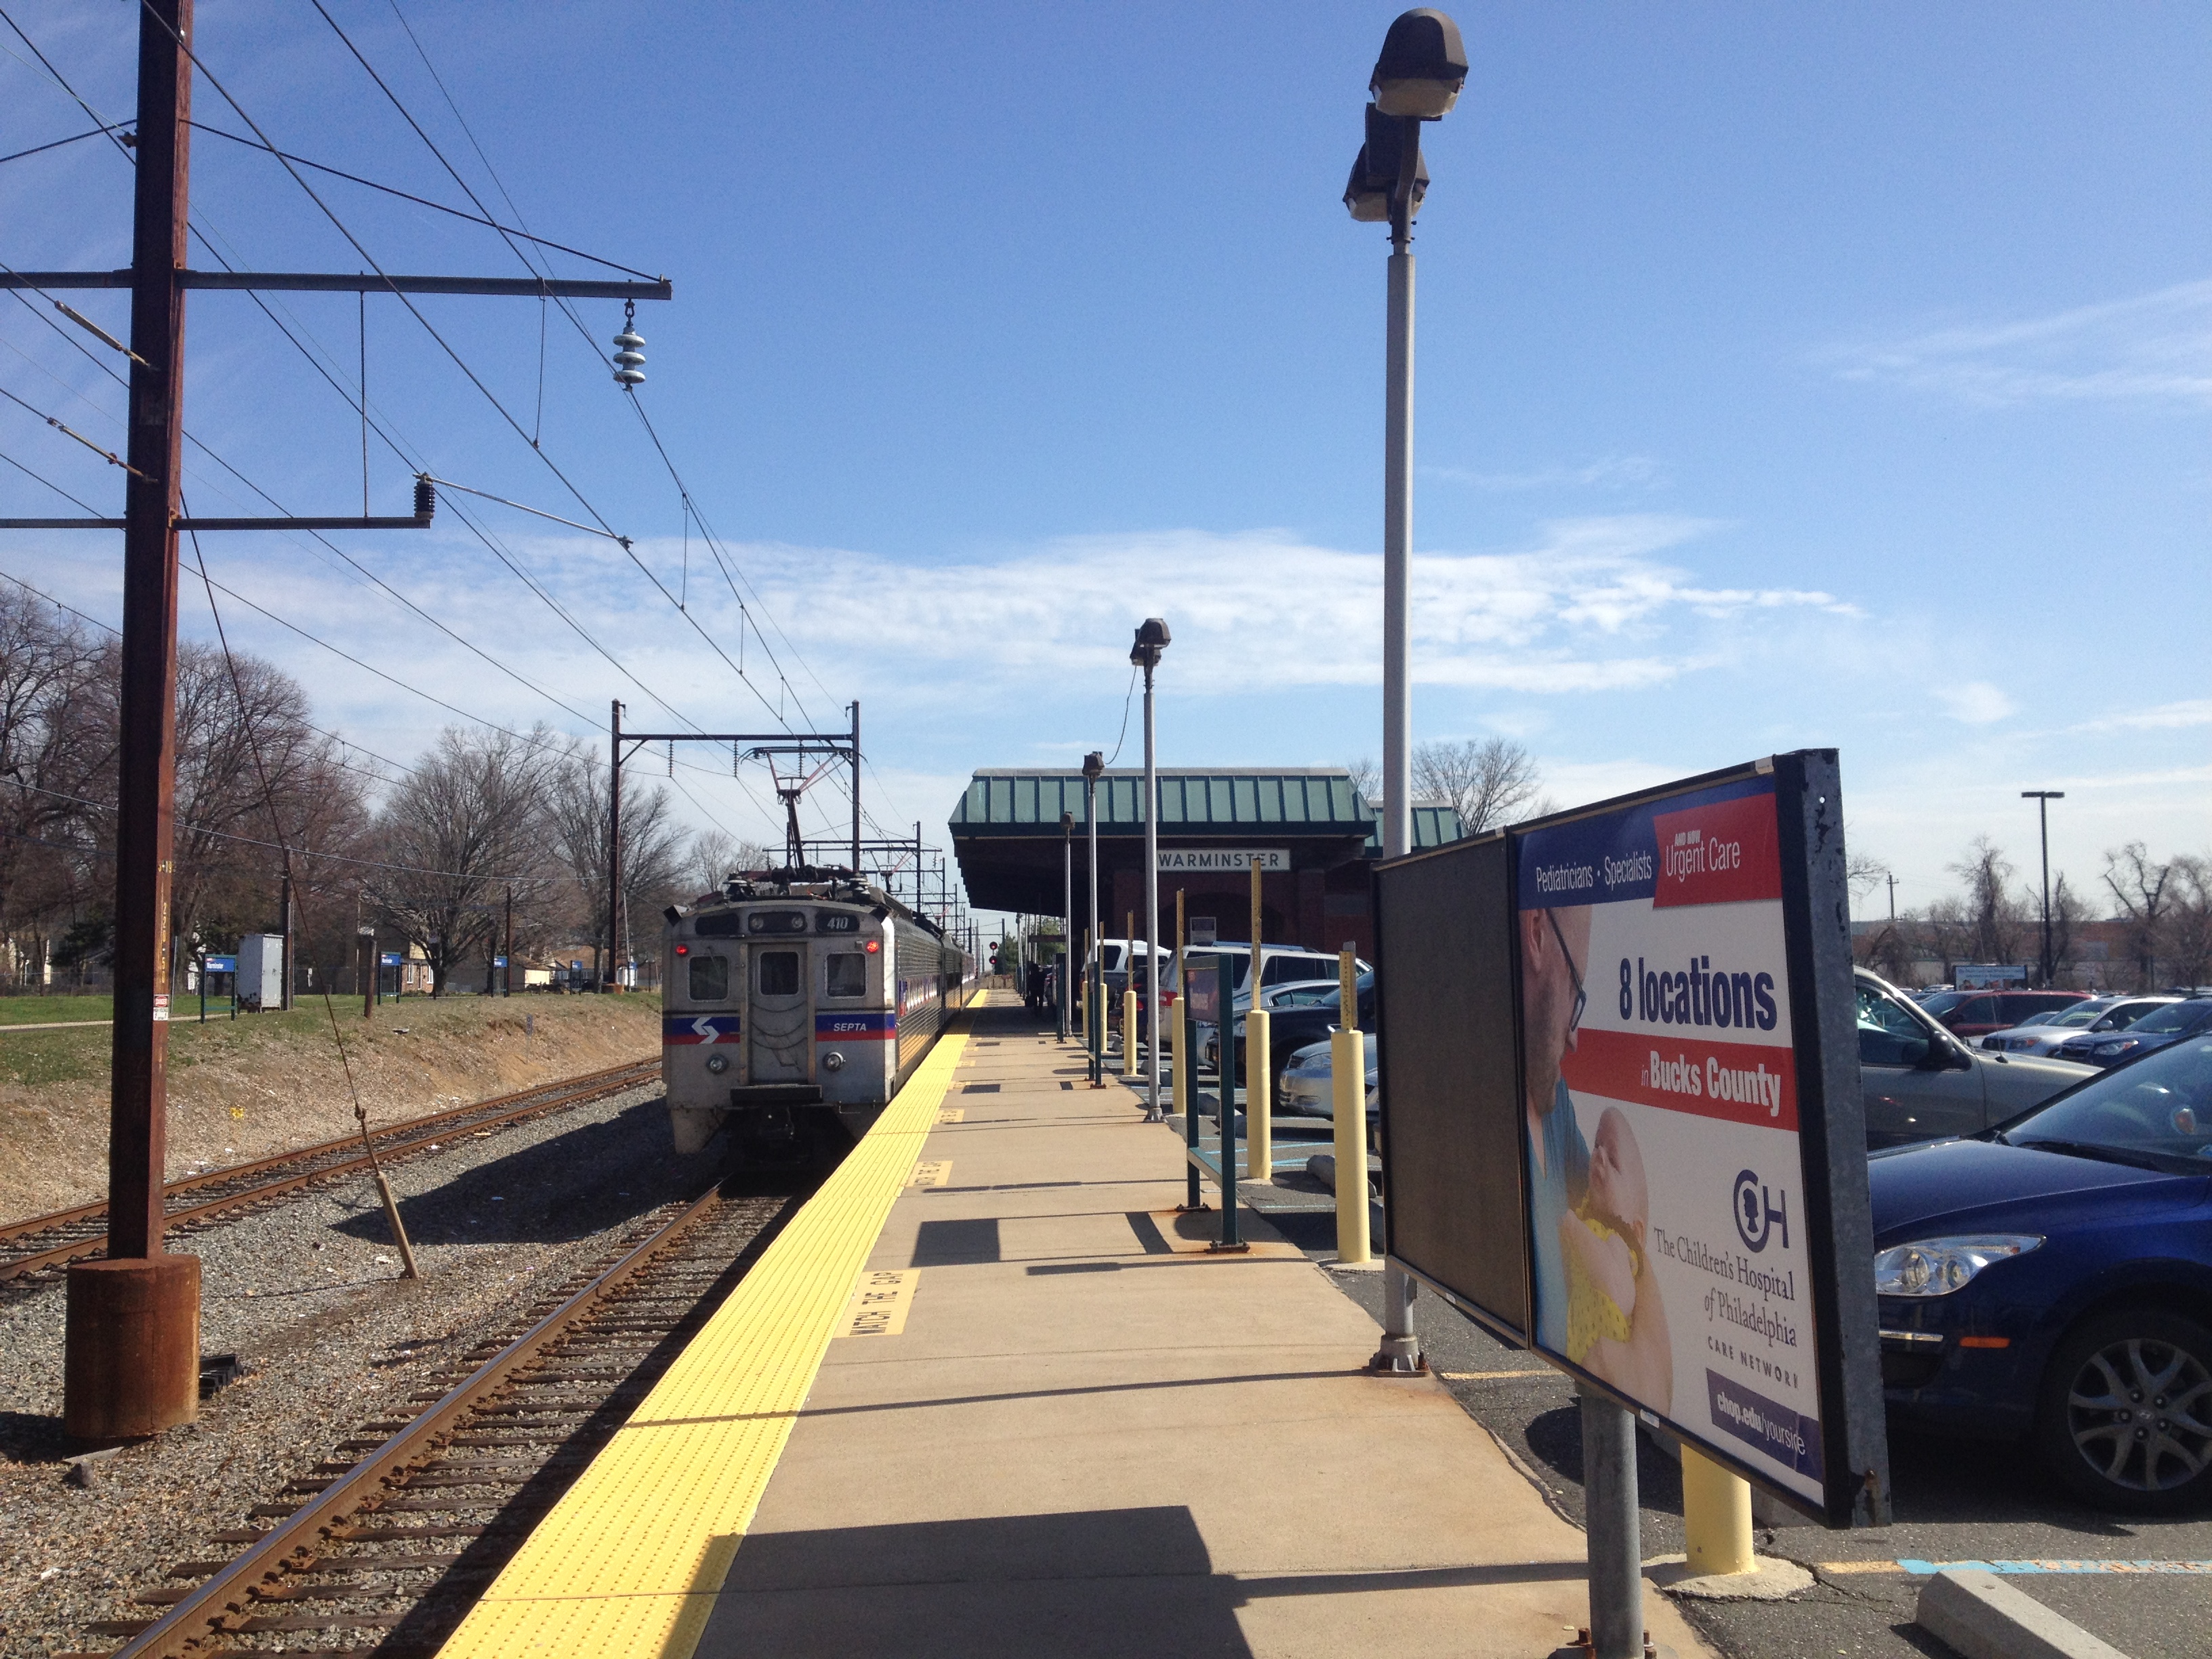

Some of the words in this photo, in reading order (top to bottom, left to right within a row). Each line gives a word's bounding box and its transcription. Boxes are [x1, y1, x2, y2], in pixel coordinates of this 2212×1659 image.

[1675, 832, 1686, 846] AND
[1687, 830, 1701, 844] NOW
[1158, 853, 1279, 867] WARMINSTER
[1536, 862, 1593, 893] Pediatricians
[1605, 851, 1652, 890] Specialists
[1666, 840, 1705, 882] Urgent
[1709, 837, 1740, 871] Care
[827, 917, 848, 929] 410
[1619, 958, 1633, 1020] 8
[1639, 955, 1778, 1031] locations
[834, 1023, 867, 1031] SEPTA
[1641, 1064, 1649, 1086] in
[1650, 1050, 1702, 1097] Bucks
[1706, 1057, 1781, 1117] County
[869, 1272, 903, 1285] GAP
[1654, 1227, 1675, 1258] The
[1677, 1236, 1734, 1280] Children's
[1736, 1255, 1795, 1301] Hospital
[862, 1291, 898, 1305] THE
[849, 1311, 892, 1336] WATCH
[1704, 1288, 1716, 1322] of
[1717, 1290, 1797, 1348] Philadelphia
[1708, 1336, 1734, 1360] CARE
[1740, 1350, 1799, 1389] NETWORK
